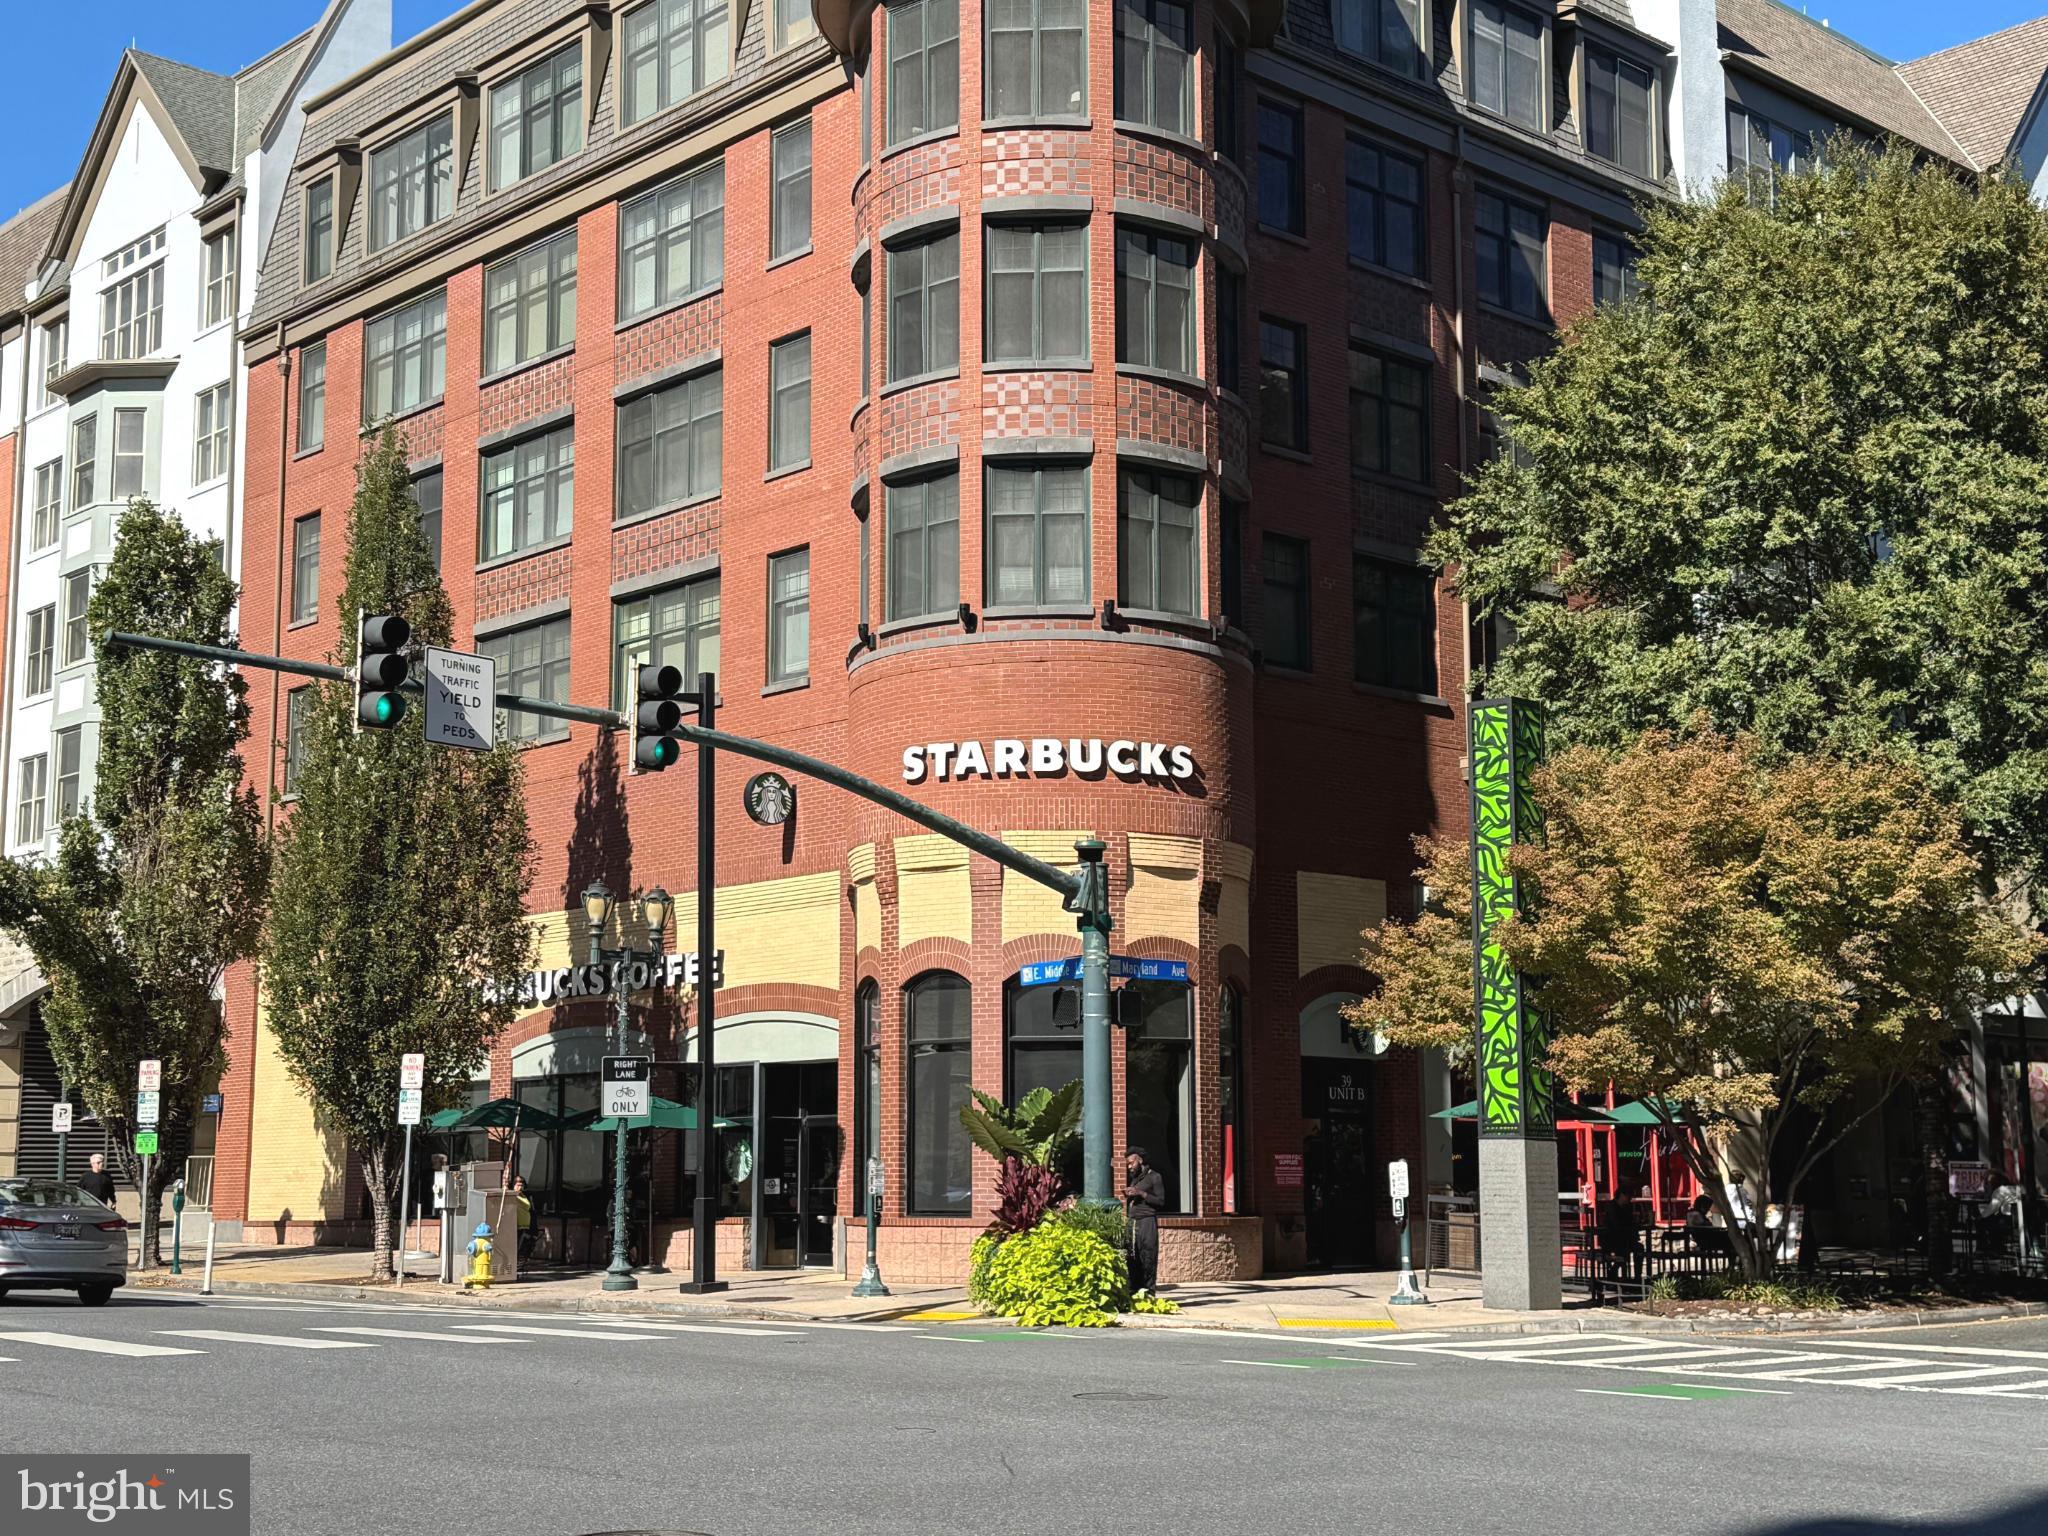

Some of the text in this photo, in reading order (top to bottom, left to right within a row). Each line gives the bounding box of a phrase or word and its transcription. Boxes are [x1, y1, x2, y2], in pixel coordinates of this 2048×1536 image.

[441, 658, 481, 674] TURNING
[442, 675, 480, 690] TRAFFIC
[440, 690, 481, 708] YIELD
[454, 711, 465, 721] TO
[443, 724, 476, 739] PEDS
[901, 738, 1194, 780] STARBUCKS
[1122, 961, 1185, 978] Maryland Ave
[614, 1060, 637, 1069] RIGHT
[615, 1070, 636, 1079] LANE
[1340, 1075, 1352, 1087] 39
[1329, 1087, 1365, 1101] UNIT B
[612, 1101, 639, 1113] ONLY
